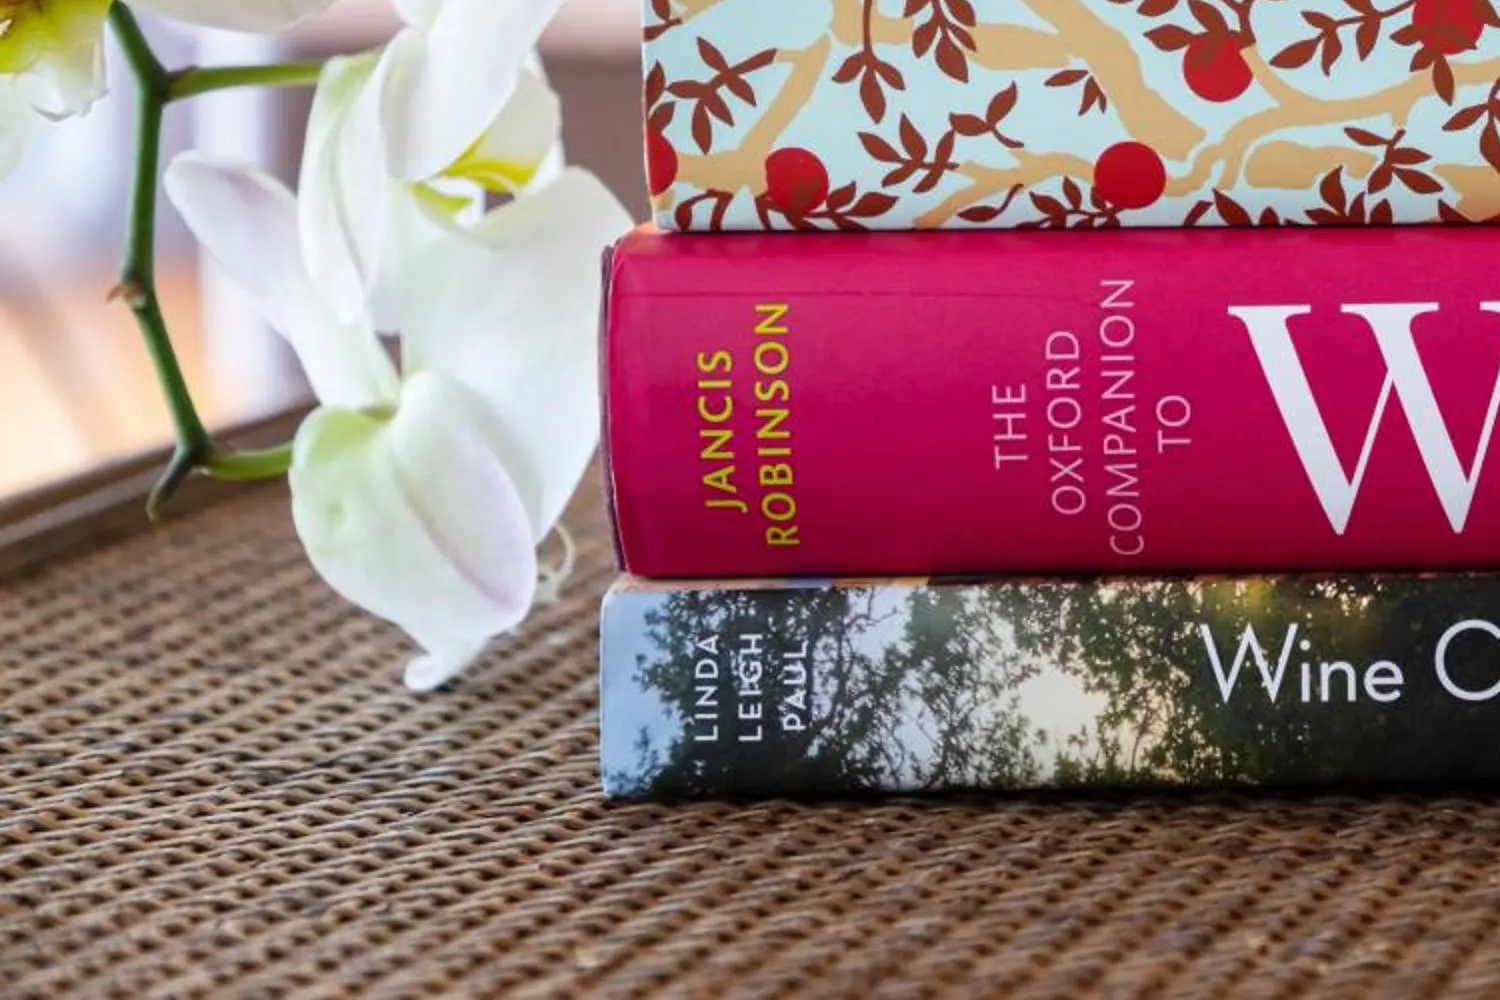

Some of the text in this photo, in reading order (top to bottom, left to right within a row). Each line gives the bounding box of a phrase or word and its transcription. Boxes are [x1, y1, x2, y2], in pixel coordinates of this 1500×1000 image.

[697, 349, 748, 512] JANCIS
[752, 303, 800, 546] ROBINSON
[992, 383, 1028, 469] THE
[1045, 330, 1086, 515] OXFORD
[1100, 279, 1144, 555] COMPANION
[1156, 394, 1192, 453] TO
[694, 635, 718, 742] LINDA
[738, 633, 763, 742] LEIGH
[783, 641, 808, 731] PAUL
[1200, 622, 1403, 704] Wine
